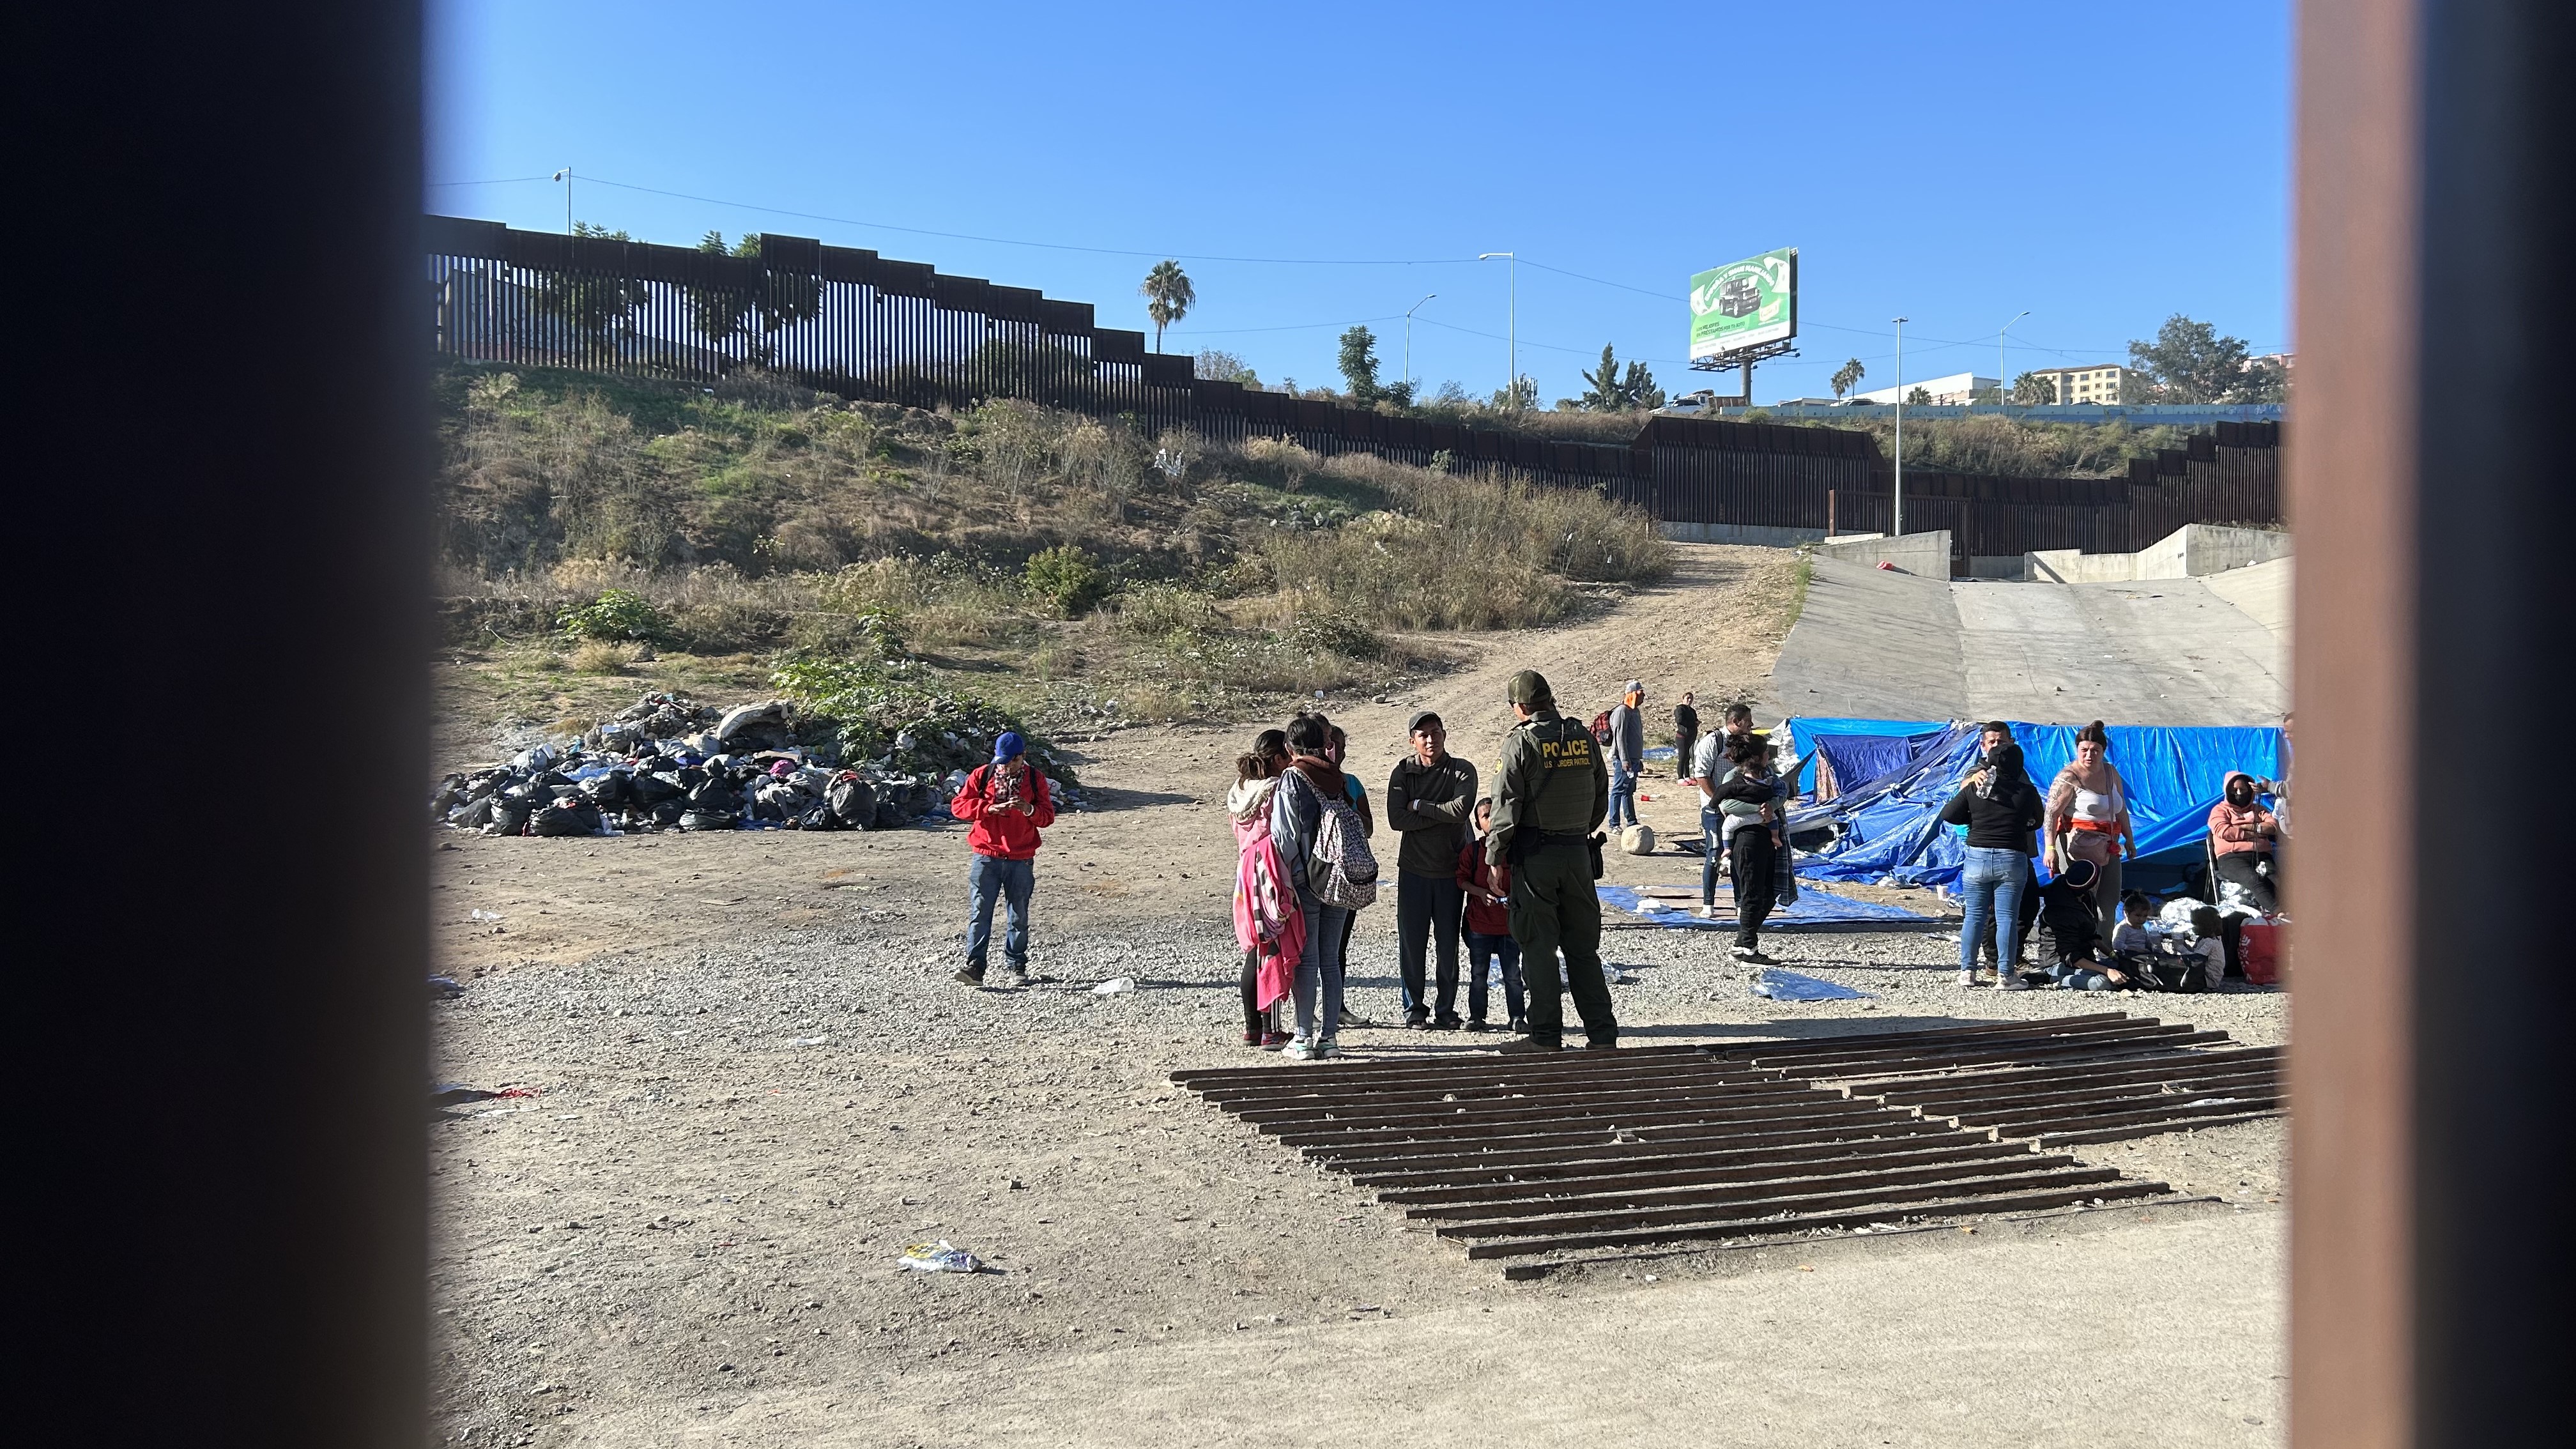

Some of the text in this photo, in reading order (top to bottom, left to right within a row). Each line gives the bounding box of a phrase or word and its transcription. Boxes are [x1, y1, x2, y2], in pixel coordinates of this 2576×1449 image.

[1542, 739, 1589, 758] POLICE
[1557, 758, 1574, 767] ORDER
[1574, 757, 1591, 766] PATROL
